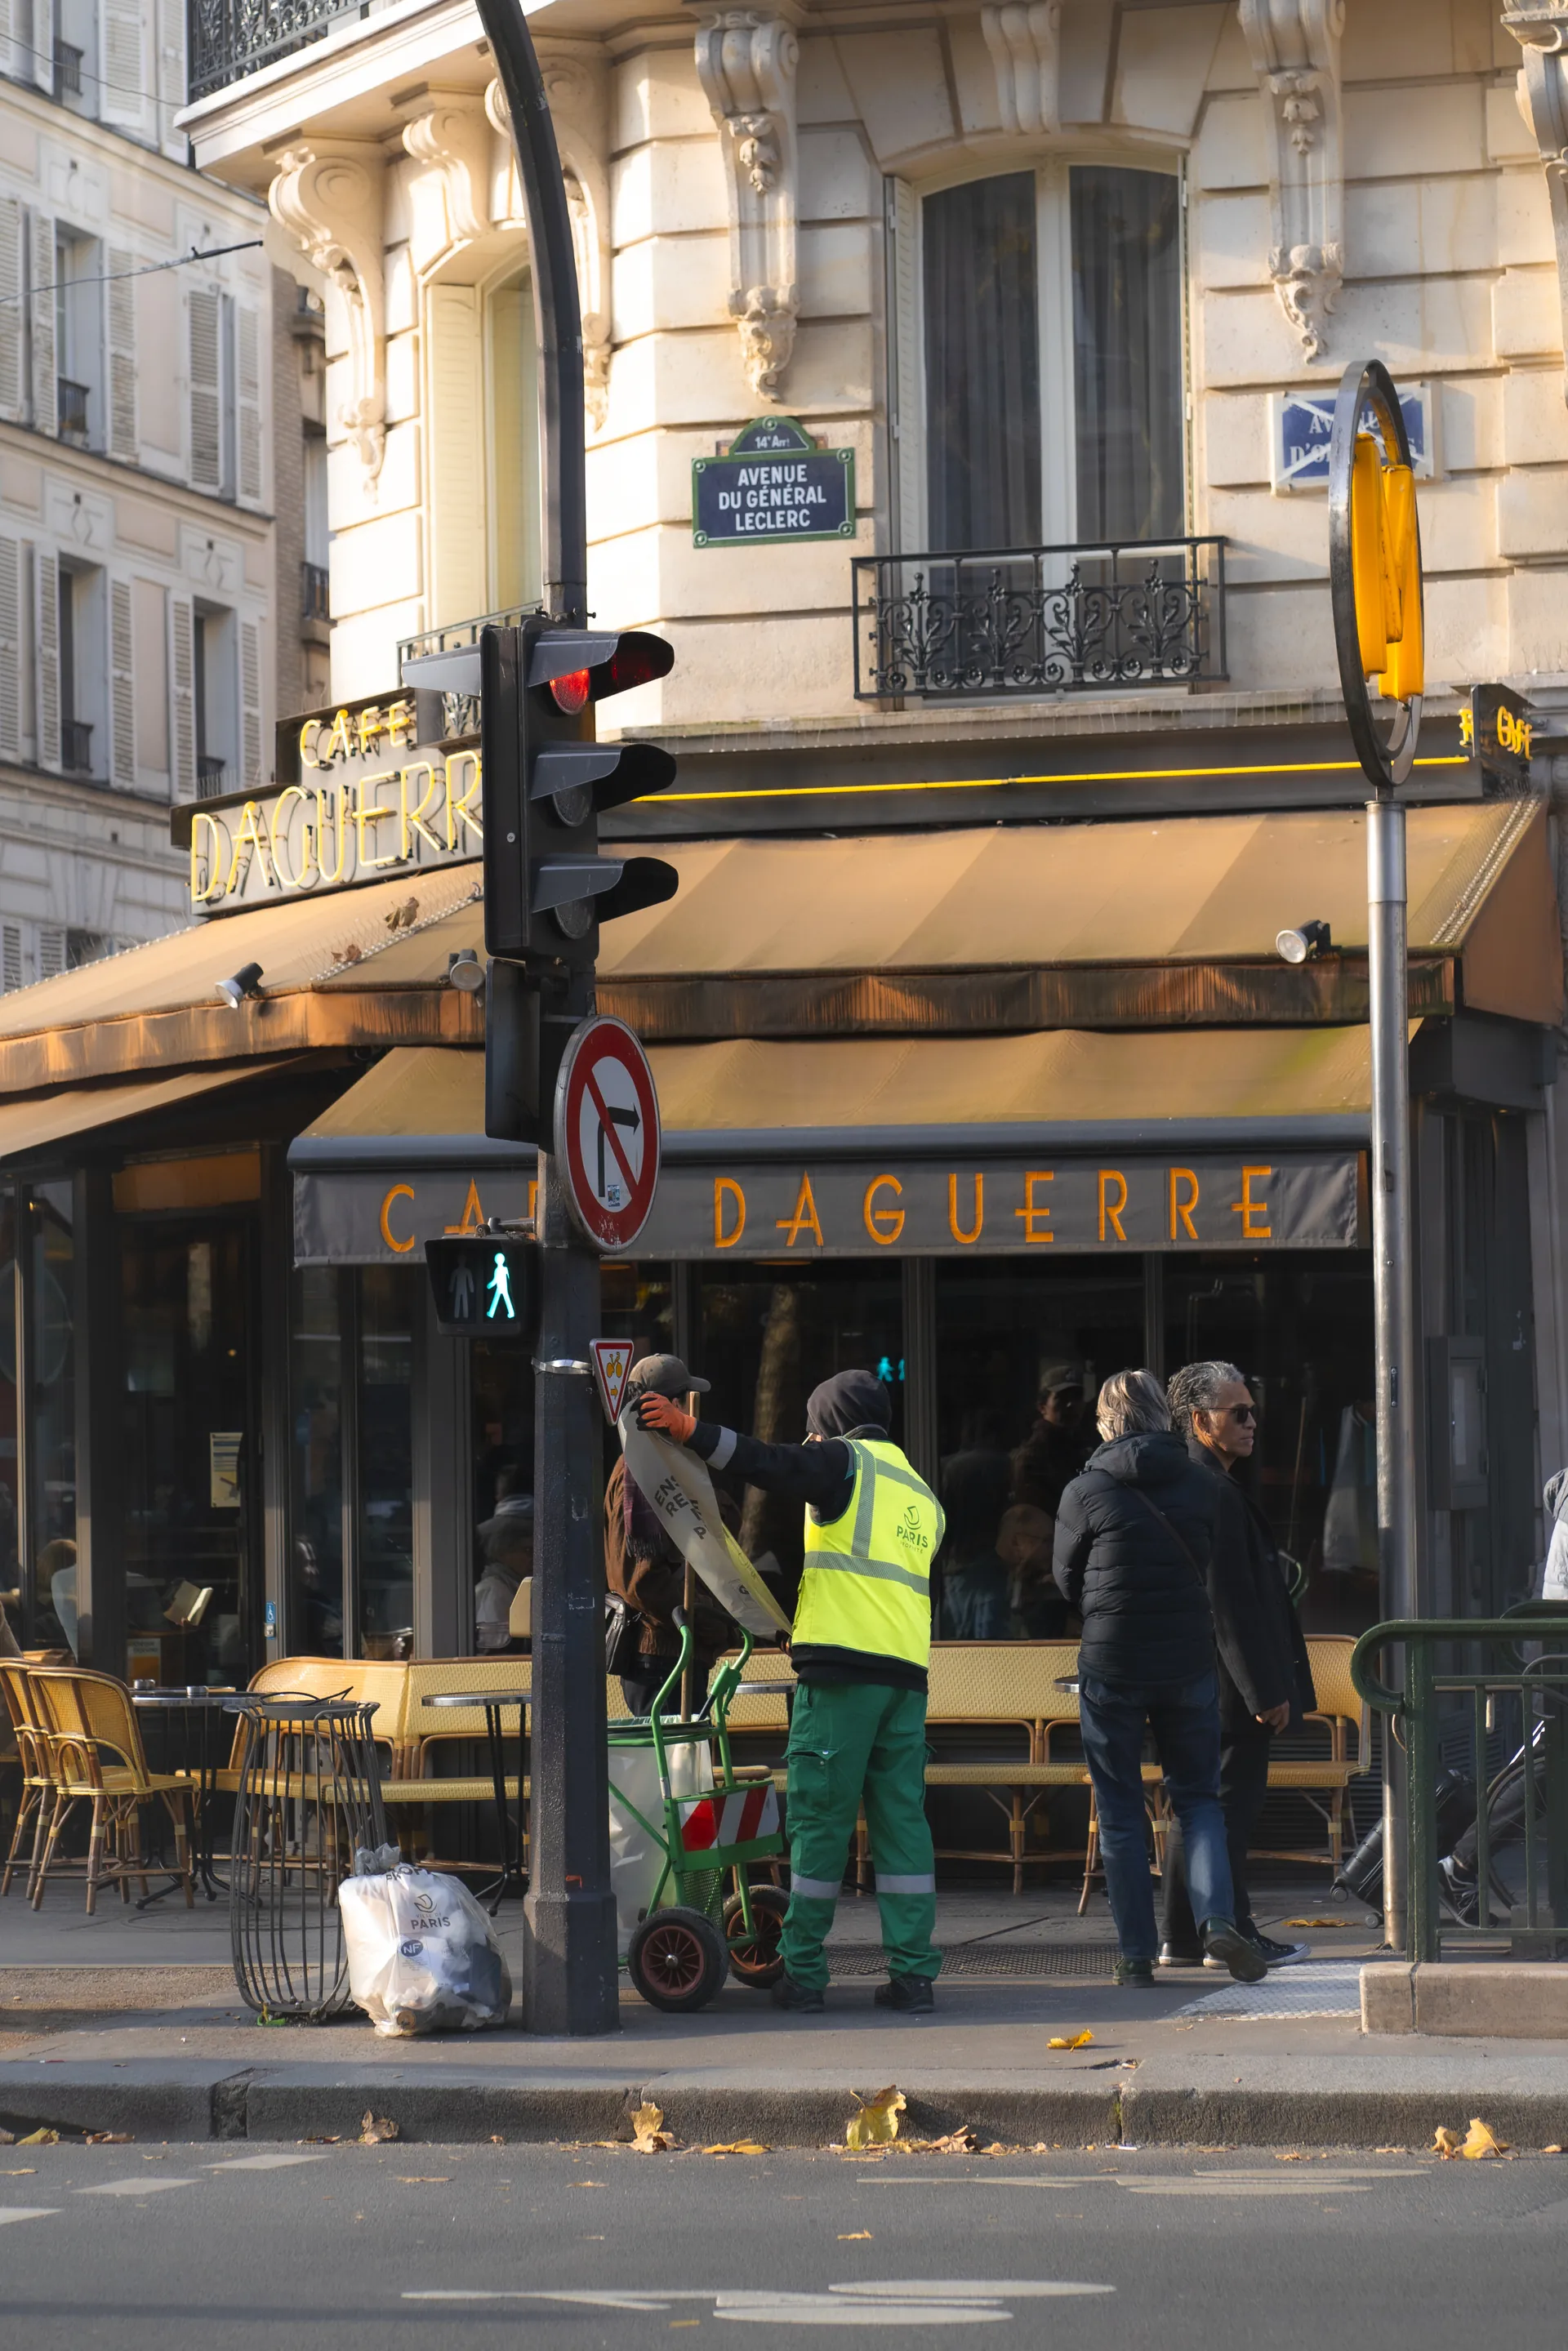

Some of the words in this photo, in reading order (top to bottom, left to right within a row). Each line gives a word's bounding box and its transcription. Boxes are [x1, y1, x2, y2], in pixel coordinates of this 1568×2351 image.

[737, 465, 807, 486] AVENUE
[719, 492, 742, 510] DU
[746, 483, 826, 508] GÉNÉRAL
[735, 509, 811, 531] LECLERC
[190, 749, 483, 902] DAGUERR
[714, 1165, 1272, 1249] DAGUERRE
[897, 1525, 929, 1548] PARIS
[411, 1917, 451, 1930] PARIS
[403, 1943, 421, 1954] NF
